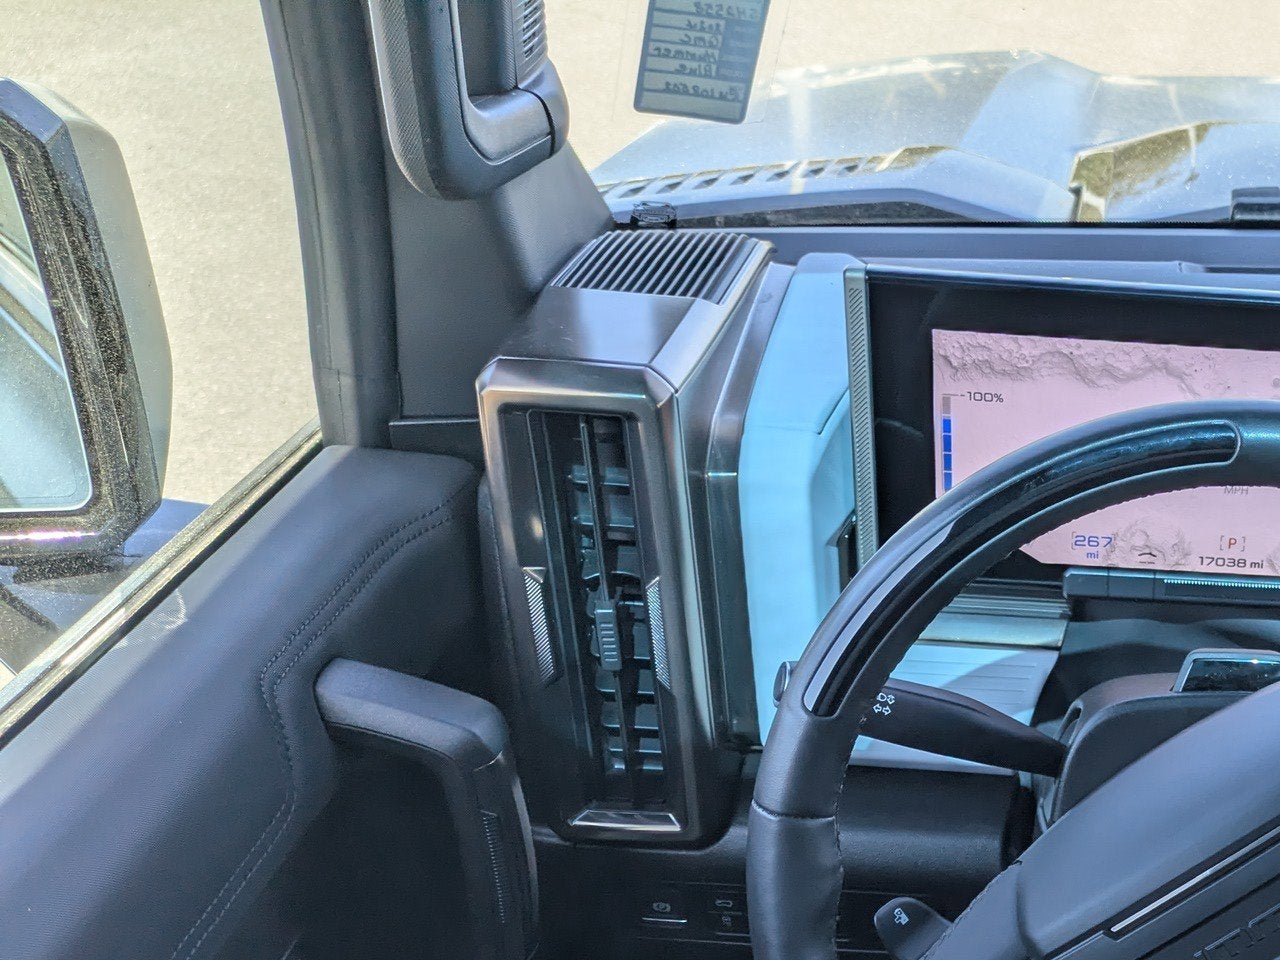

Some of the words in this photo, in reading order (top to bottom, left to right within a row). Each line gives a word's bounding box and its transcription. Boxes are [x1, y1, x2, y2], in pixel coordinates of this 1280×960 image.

[967, 391, 1004, 403] 100%
[1224, 486, 1249, 495] MPH
[1074, 535, 1113, 548] 267
[1228, 538, 1238, 550] P
[1086, 550, 1099, 560] mi
[1199, 556, 1247, 569] 17038
[1250, 558, 1264, 569] mi
